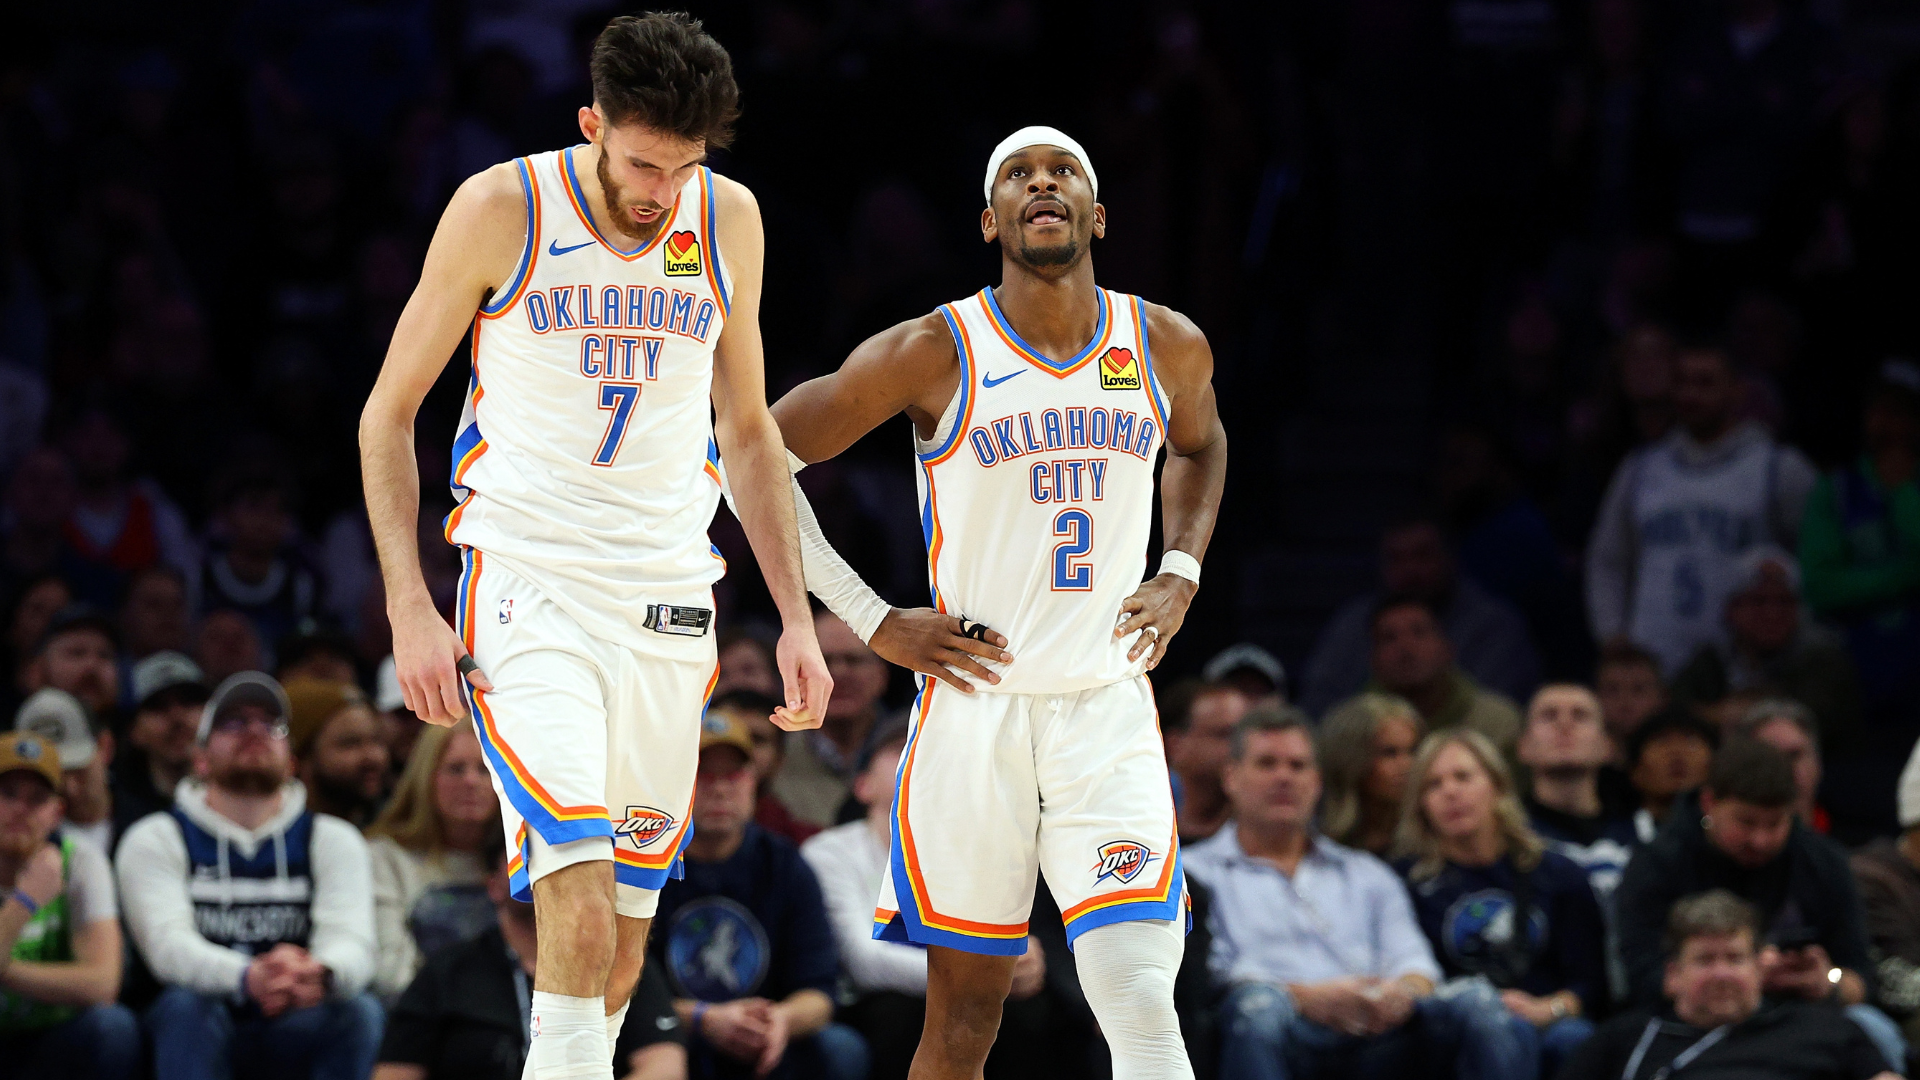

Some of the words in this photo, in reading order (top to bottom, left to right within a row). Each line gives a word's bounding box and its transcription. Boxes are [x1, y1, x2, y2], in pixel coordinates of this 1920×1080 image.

[524, 285, 715, 344] OKLAHOMA
[580, 334, 664, 381] CITY
[591, 381, 642, 467] 7
[969, 407, 1156, 468] OKLAHOMA
[1030, 458, 1108, 504] CITY
[1051, 507, 1093, 591] 2
[615, 816, 665, 834] OKC
[1097, 849, 1140, 878] OKC
